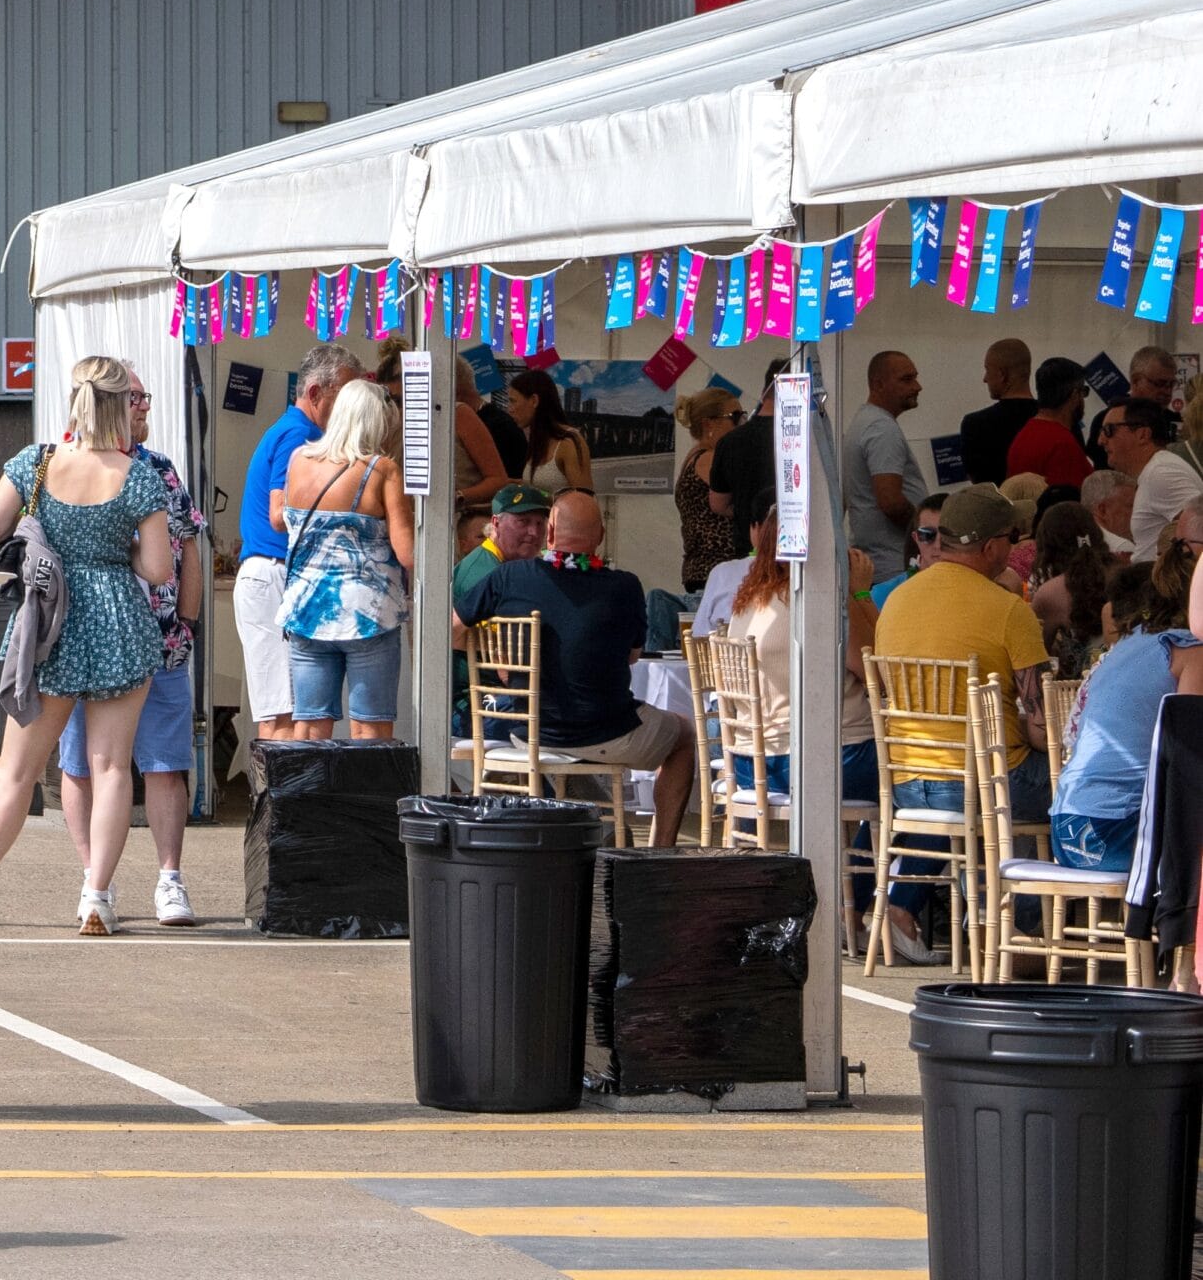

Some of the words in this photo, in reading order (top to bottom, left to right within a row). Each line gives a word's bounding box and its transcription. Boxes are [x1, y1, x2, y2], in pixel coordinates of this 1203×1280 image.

[829, 276, 853, 290] beating
[781, 400, 803, 418] Summer
[781, 418, 801, 438] Festival
